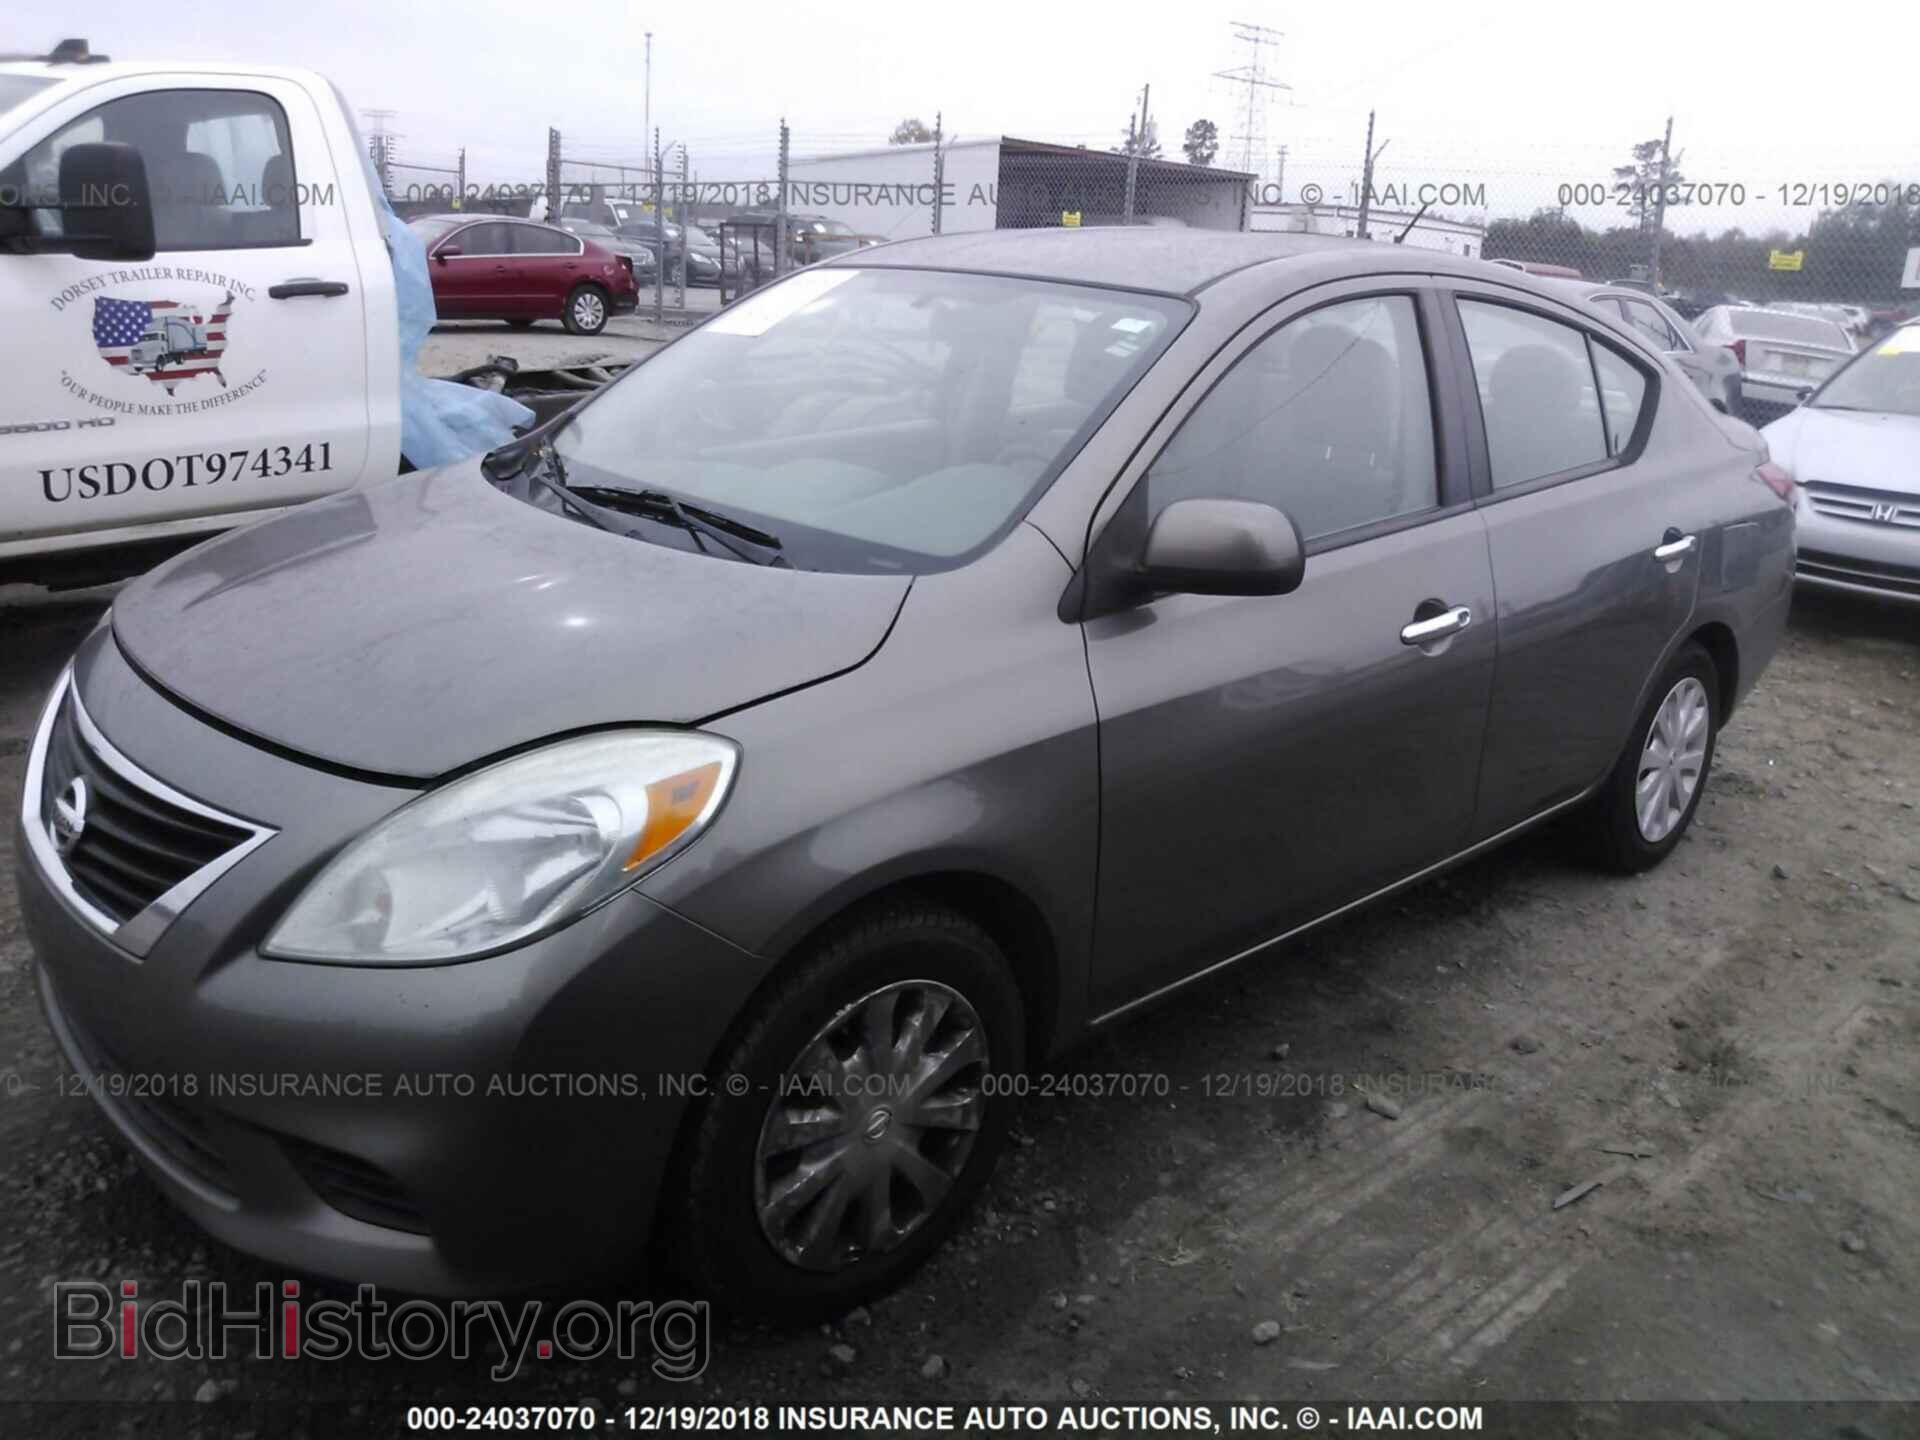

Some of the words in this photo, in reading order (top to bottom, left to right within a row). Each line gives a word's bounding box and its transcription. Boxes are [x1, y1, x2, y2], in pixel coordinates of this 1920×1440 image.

[51, 274, 107, 312] DORSEY
[108, 267, 173, 285] TRAILER
[175, 268, 227, 288] REPAIR
[229, 278, 256, 302] INC
[88, 393, 136, 415] PEOPLE
[137, 404, 174, 416] MAKE
[175, 401, 200, 415] THE
[38, 442, 334, 502] USDOT974341
